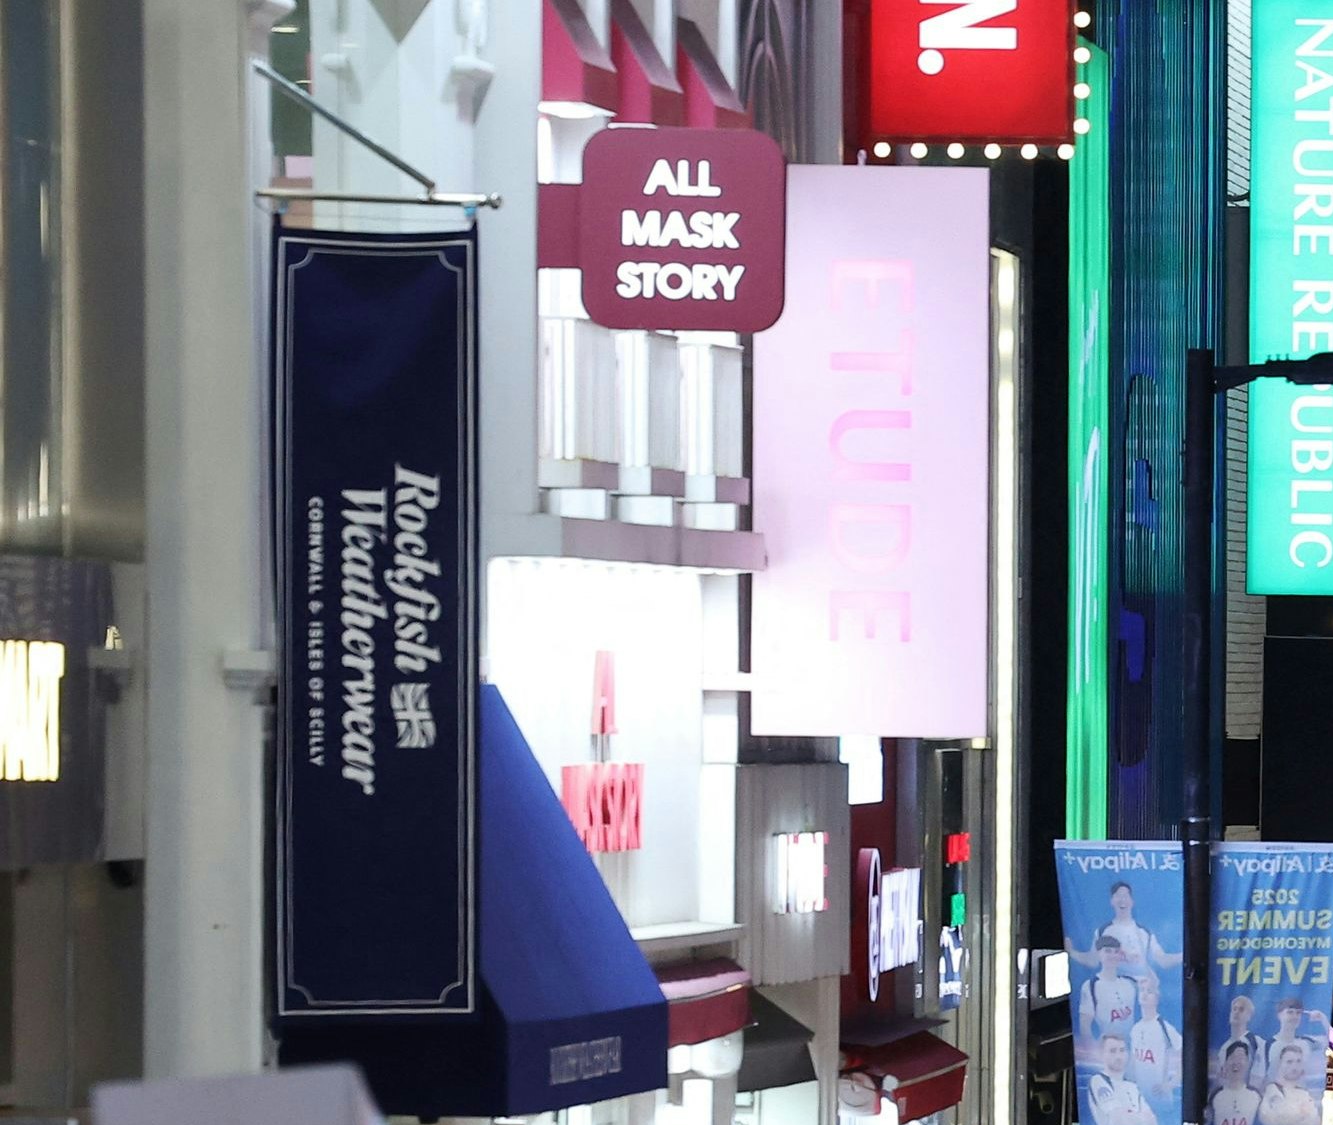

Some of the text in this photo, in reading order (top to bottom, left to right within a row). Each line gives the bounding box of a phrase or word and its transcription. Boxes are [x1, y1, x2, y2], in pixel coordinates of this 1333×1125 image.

[643, 159, 722, 197] ALL
[621, 209, 741, 249] MASK
[616, 261, 745, 301] STORY
[829, 259, 915, 642] ETUDE
[307, 496, 324, 594] CORNWALL
[384, 461, 442, 674] Rockfish
[308, 621, 324, 671] ISLES
[340, 487, 388, 796] Weatherwear
[308, 677, 324, 701] OF
[308, 706, 325, 767] SCILLY
